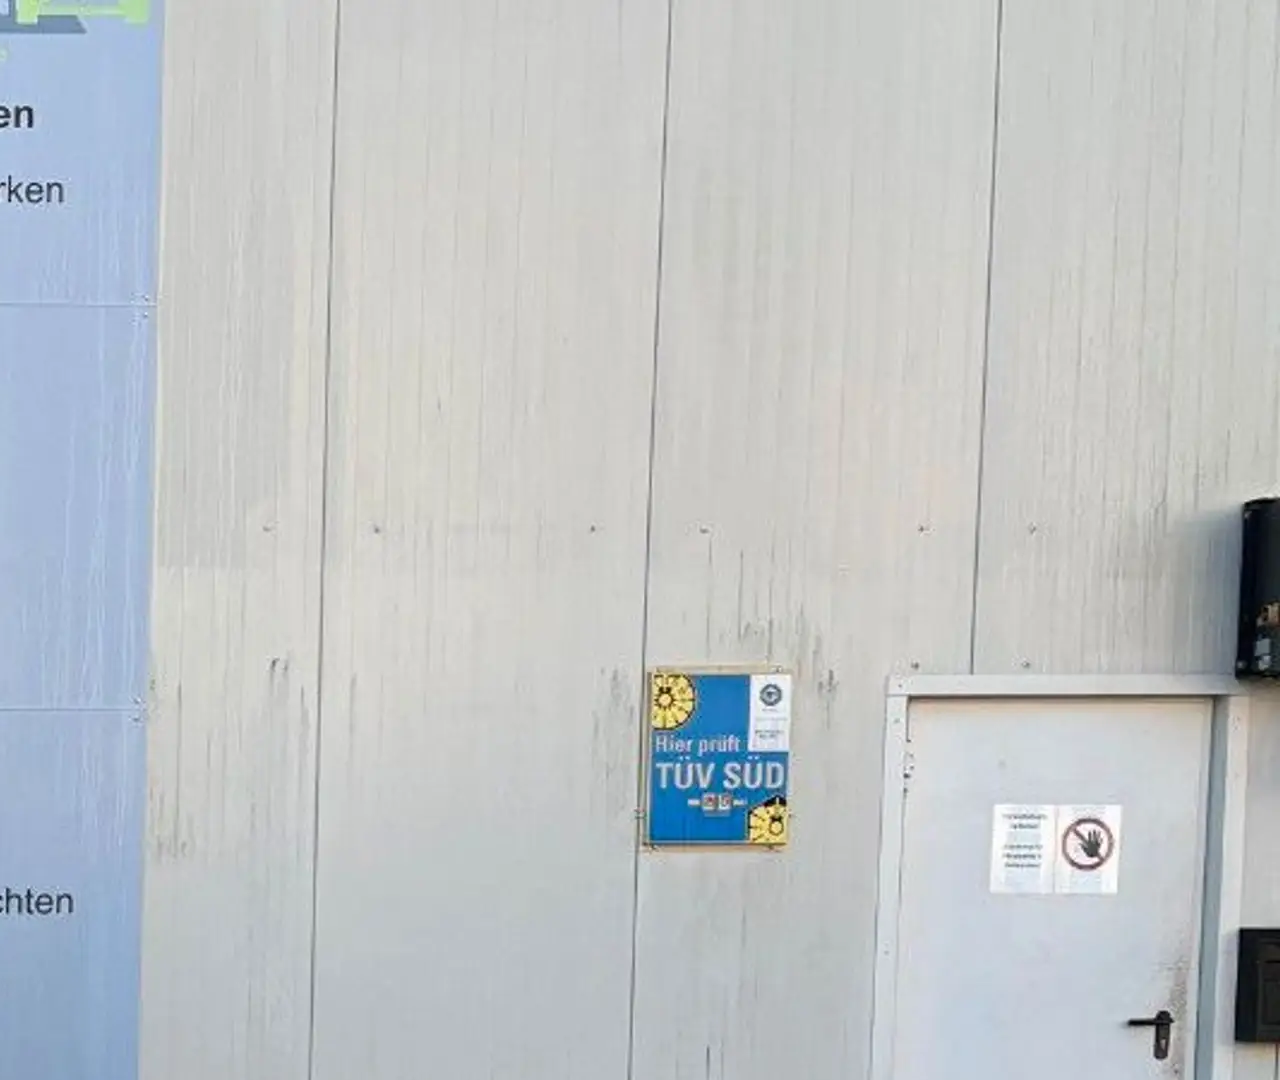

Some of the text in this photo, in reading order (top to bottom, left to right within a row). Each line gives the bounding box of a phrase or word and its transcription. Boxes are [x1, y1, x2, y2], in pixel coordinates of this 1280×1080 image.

[655, 733, 693, 753] Hier
[698, 732, 741, 756] prüft
[655, 755, 785, 790] TÜV SÜD
